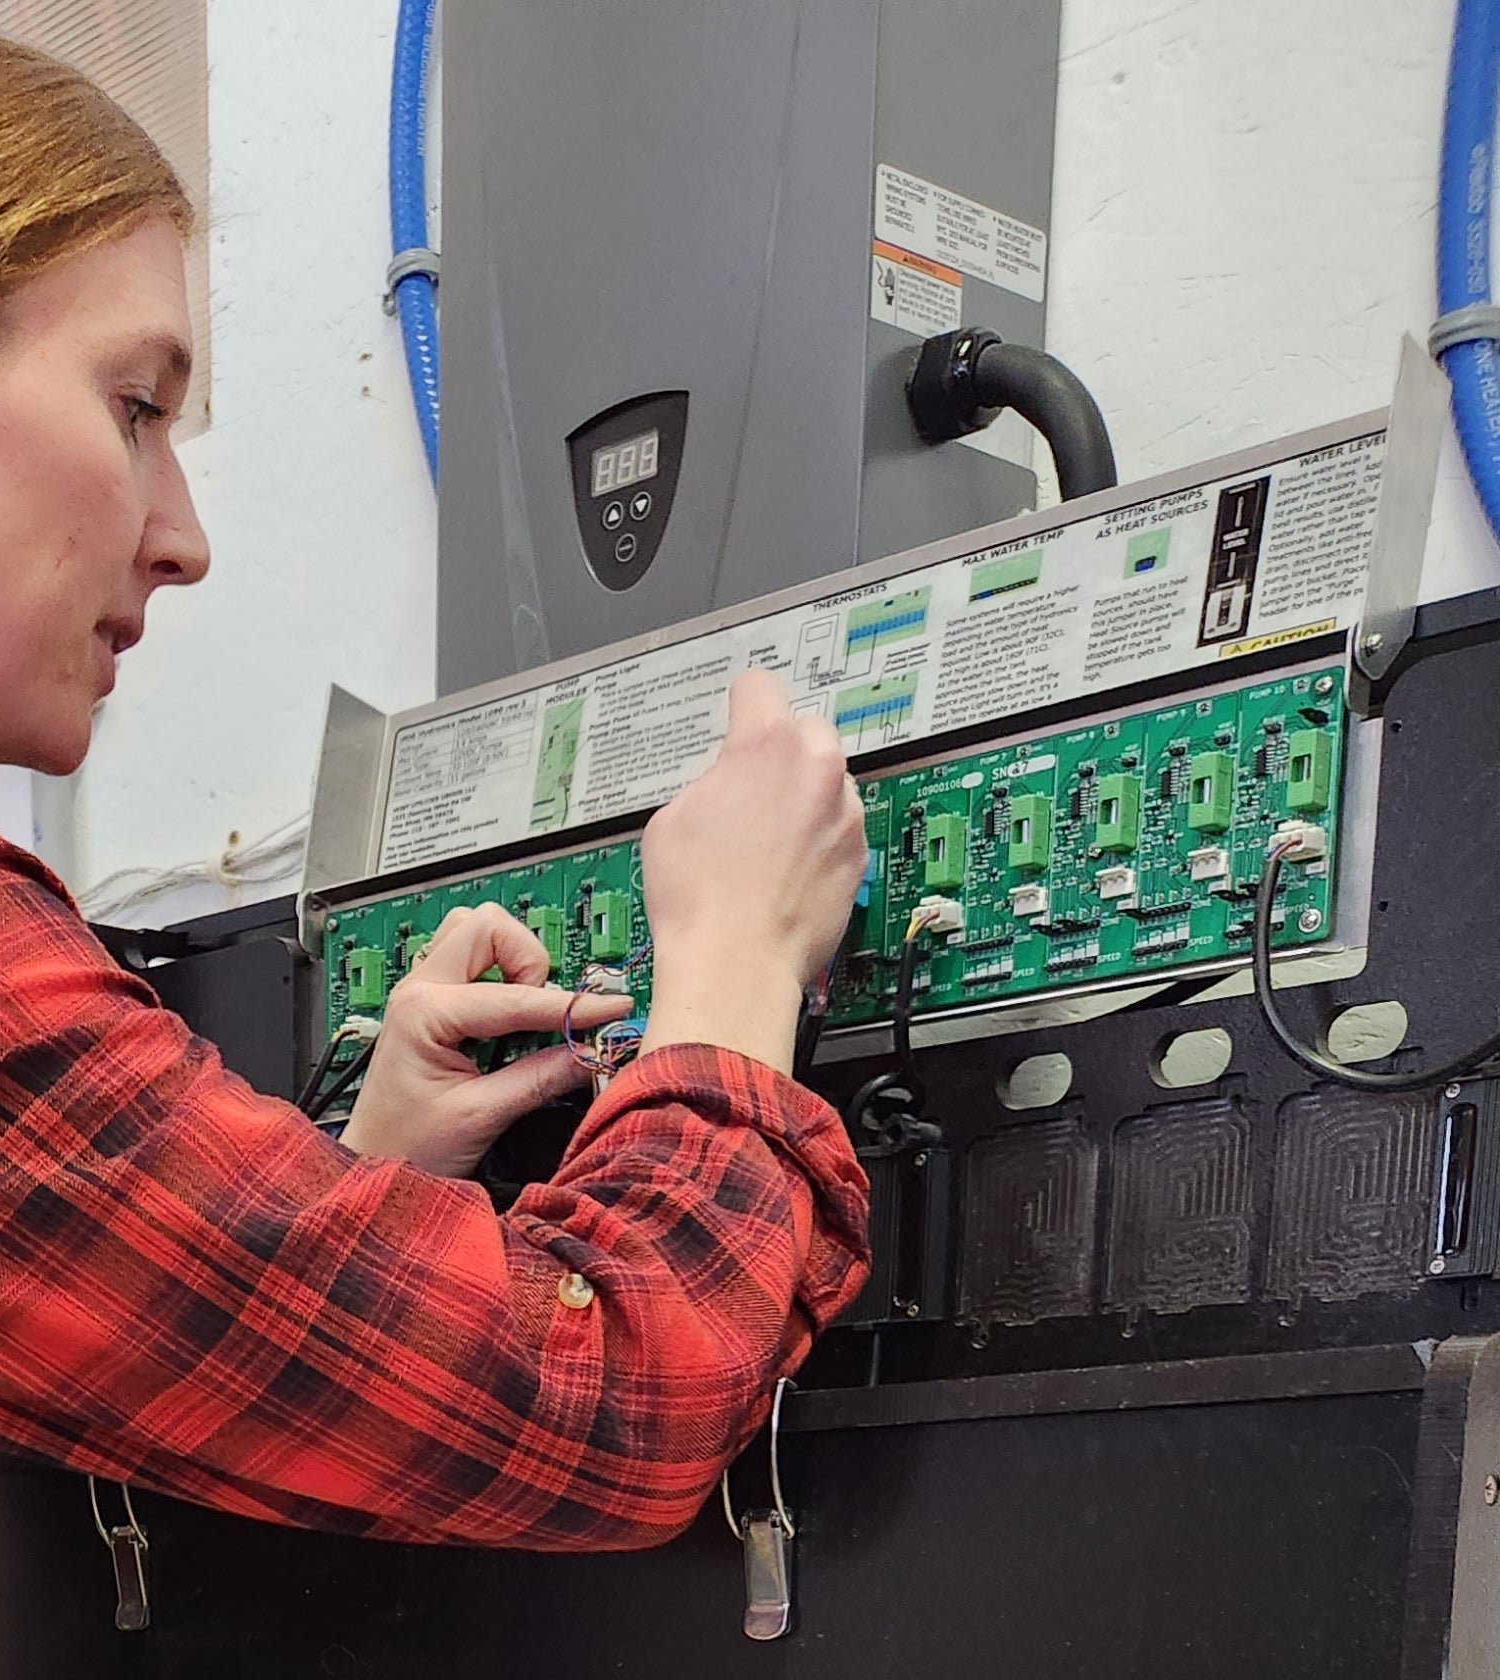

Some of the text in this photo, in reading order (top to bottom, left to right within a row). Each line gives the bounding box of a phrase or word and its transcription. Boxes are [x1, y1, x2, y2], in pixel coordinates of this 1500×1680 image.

[1299, 447, 1344, 467] WATER
[1095, 500, 1209, 540] AS HEAT SOURCES
[1103, 489, 1203, 525] SETTING PUMPS
[962, 530, 1064, 567] MAX WATER TEMP
[813, 583, 887, 612] THERMOSTATS
[545, 678, 588, 706] PUMP MODULES
[992, 767, 1008, 780] SN
[1189, 935, 1214, 946] SPEED
[1097, 952, 1121, 963] SPEED
